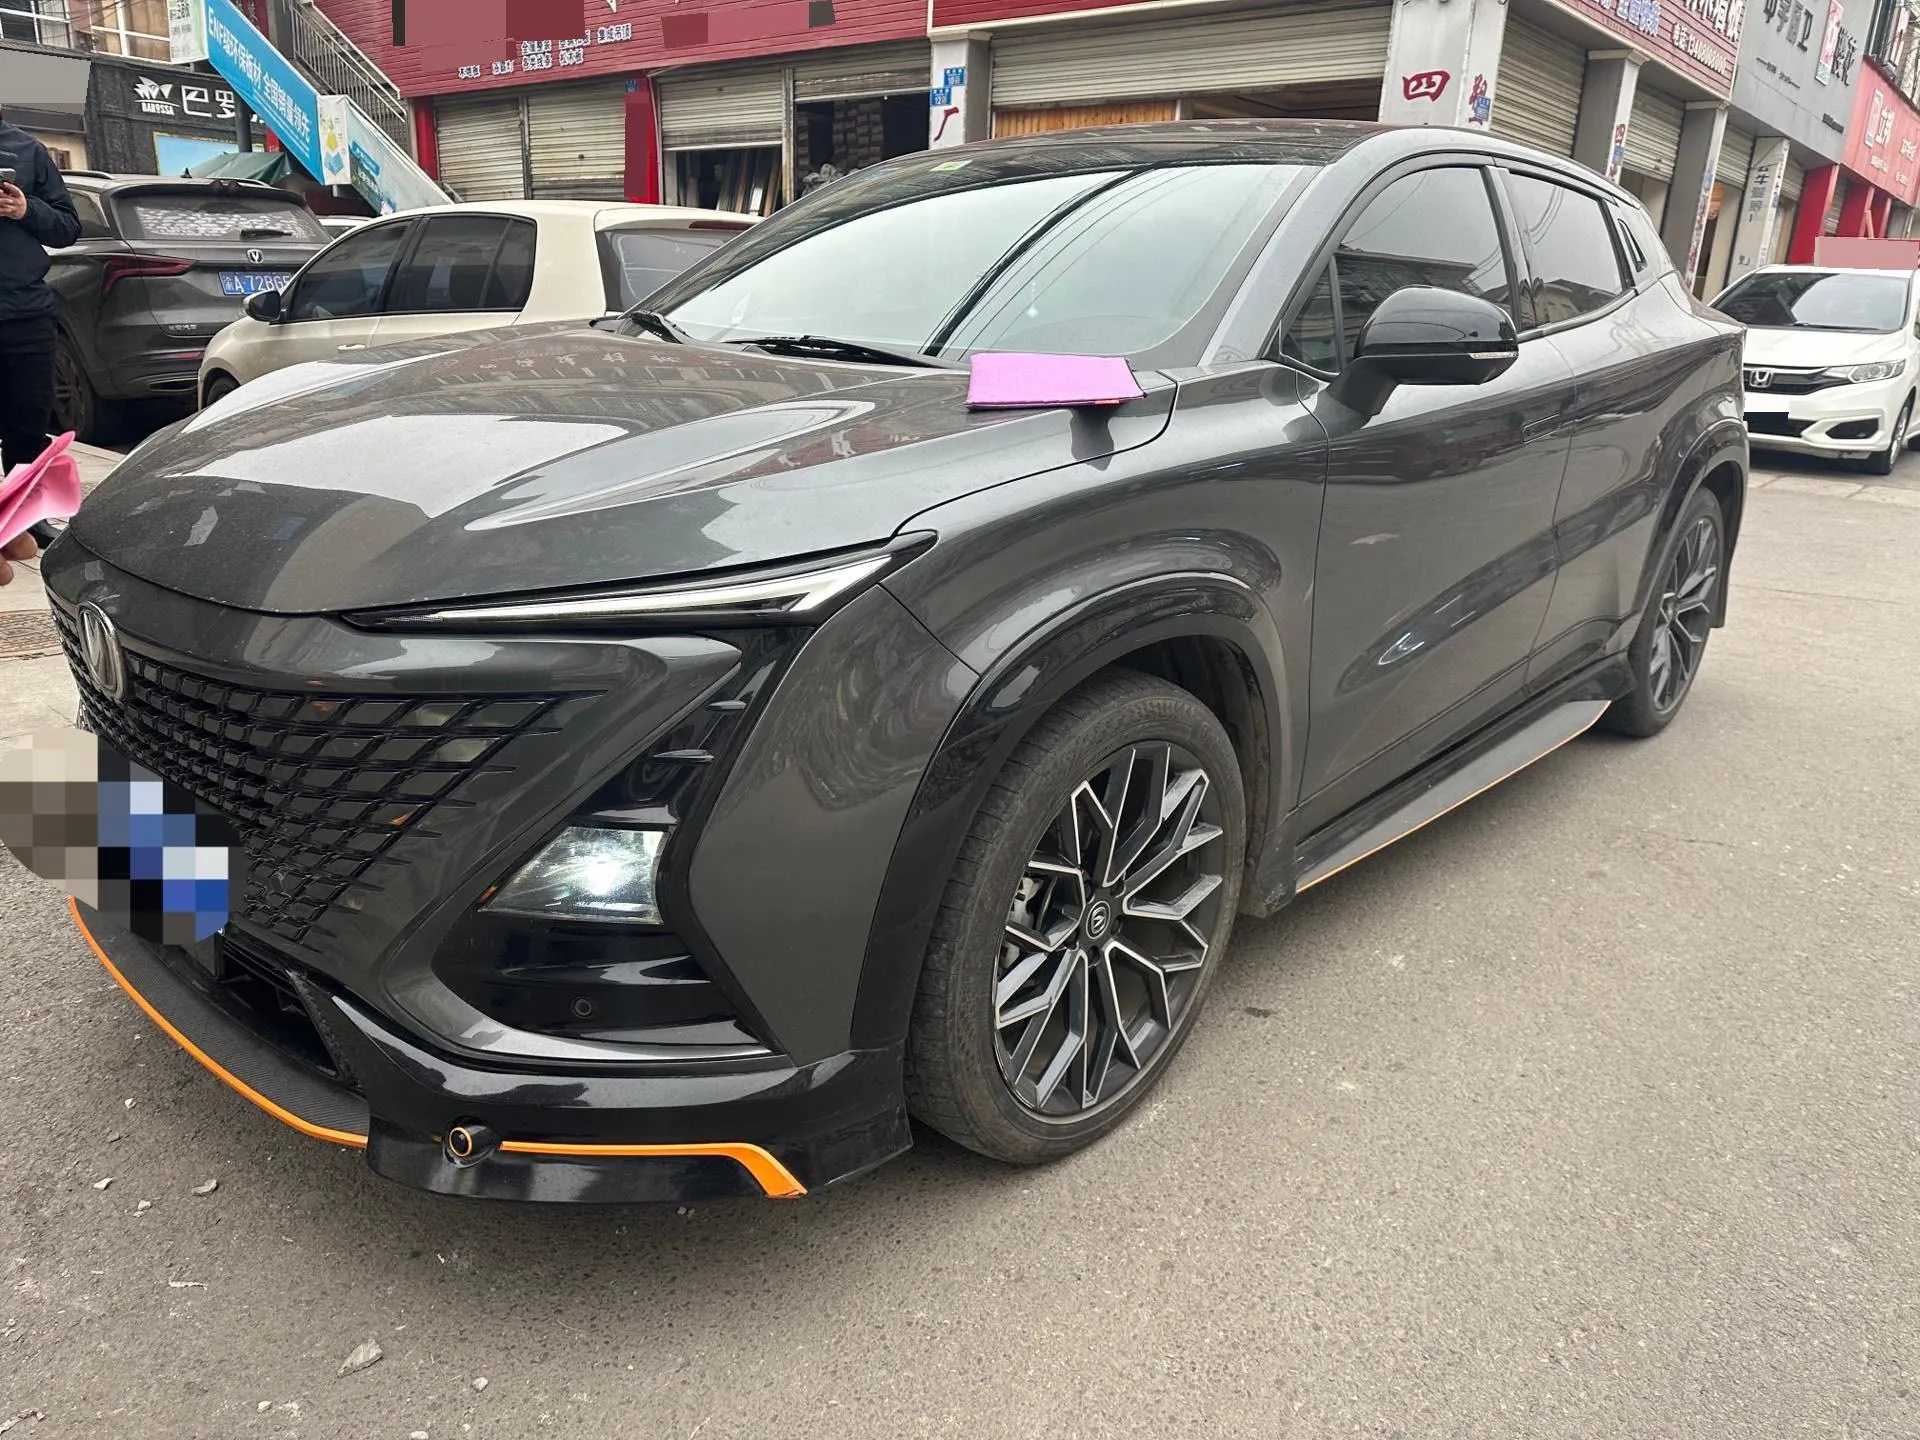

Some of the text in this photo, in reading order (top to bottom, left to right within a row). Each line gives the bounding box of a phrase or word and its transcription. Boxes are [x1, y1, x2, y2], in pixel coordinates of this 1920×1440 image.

[598, 23, 631, 43] 集成吊顶
[522, 53, 552, 71] 各类线条
[1402, 70, 1451, 102] 四
[141, 102, 175, 116] BAROSSA
